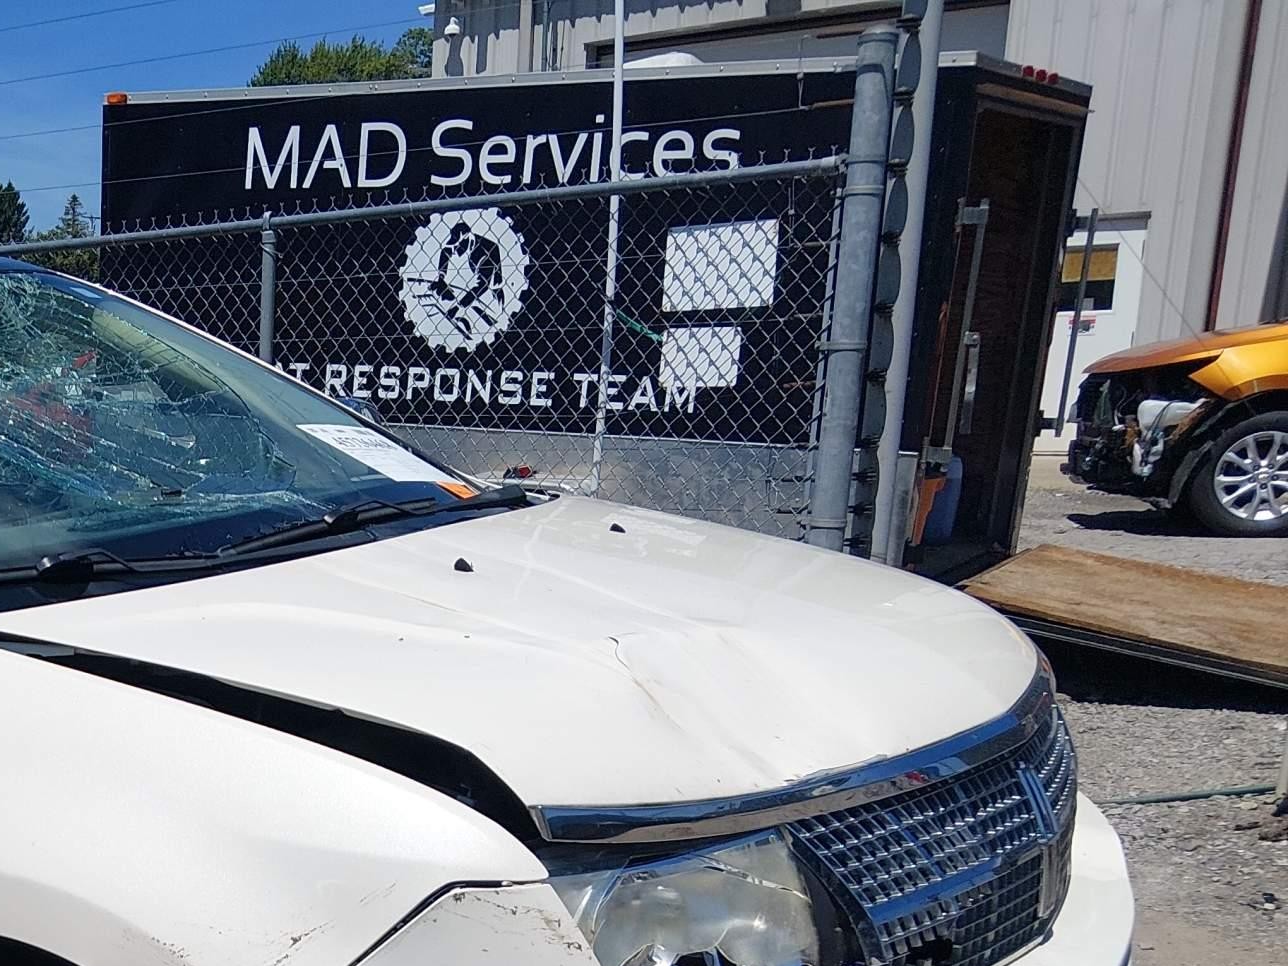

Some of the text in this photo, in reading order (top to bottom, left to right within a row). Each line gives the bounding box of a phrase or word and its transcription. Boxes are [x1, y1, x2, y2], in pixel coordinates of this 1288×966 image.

[244, 113, 741, 190] MAD Services
[324, 363, 556, 407] RESPONSE
[572, 372, 697, 414] TEAM
